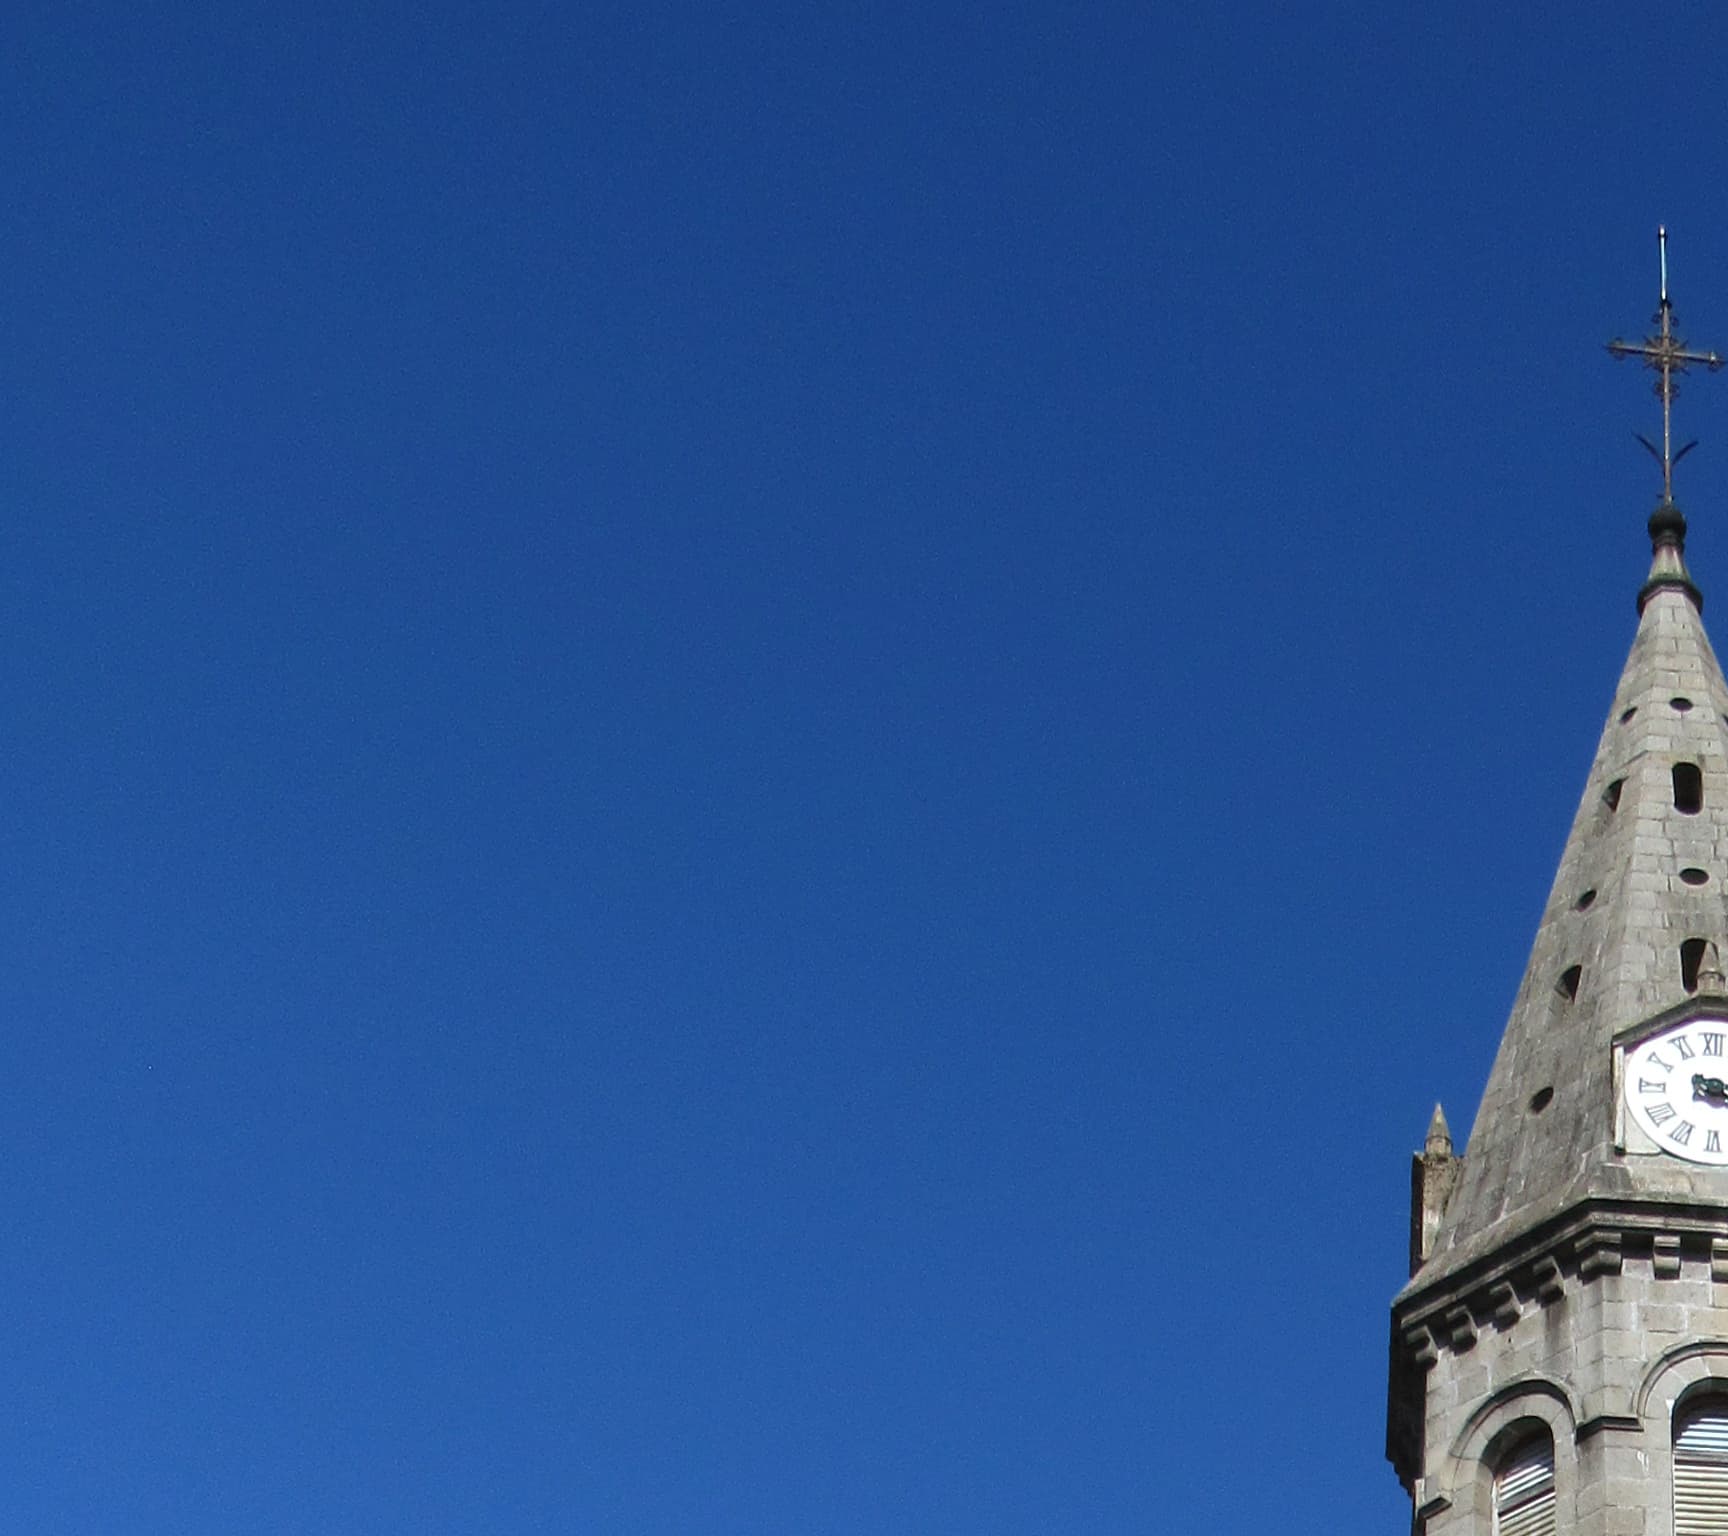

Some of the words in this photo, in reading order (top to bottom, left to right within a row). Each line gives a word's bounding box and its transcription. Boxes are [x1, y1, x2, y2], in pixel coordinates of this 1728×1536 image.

[1667, 1034, 1696, 1061] XI
[1698, 1032, 1726, 1057] XII
[1647, 1051, 1674, 1073] X
[1639, 1077, 1666, 1094] IX
[1644, 1102, 1677, 1128] VIII
[1667, 1120, 1696, 1146] VII
[1703, 1129, 1724, 1153] VI
